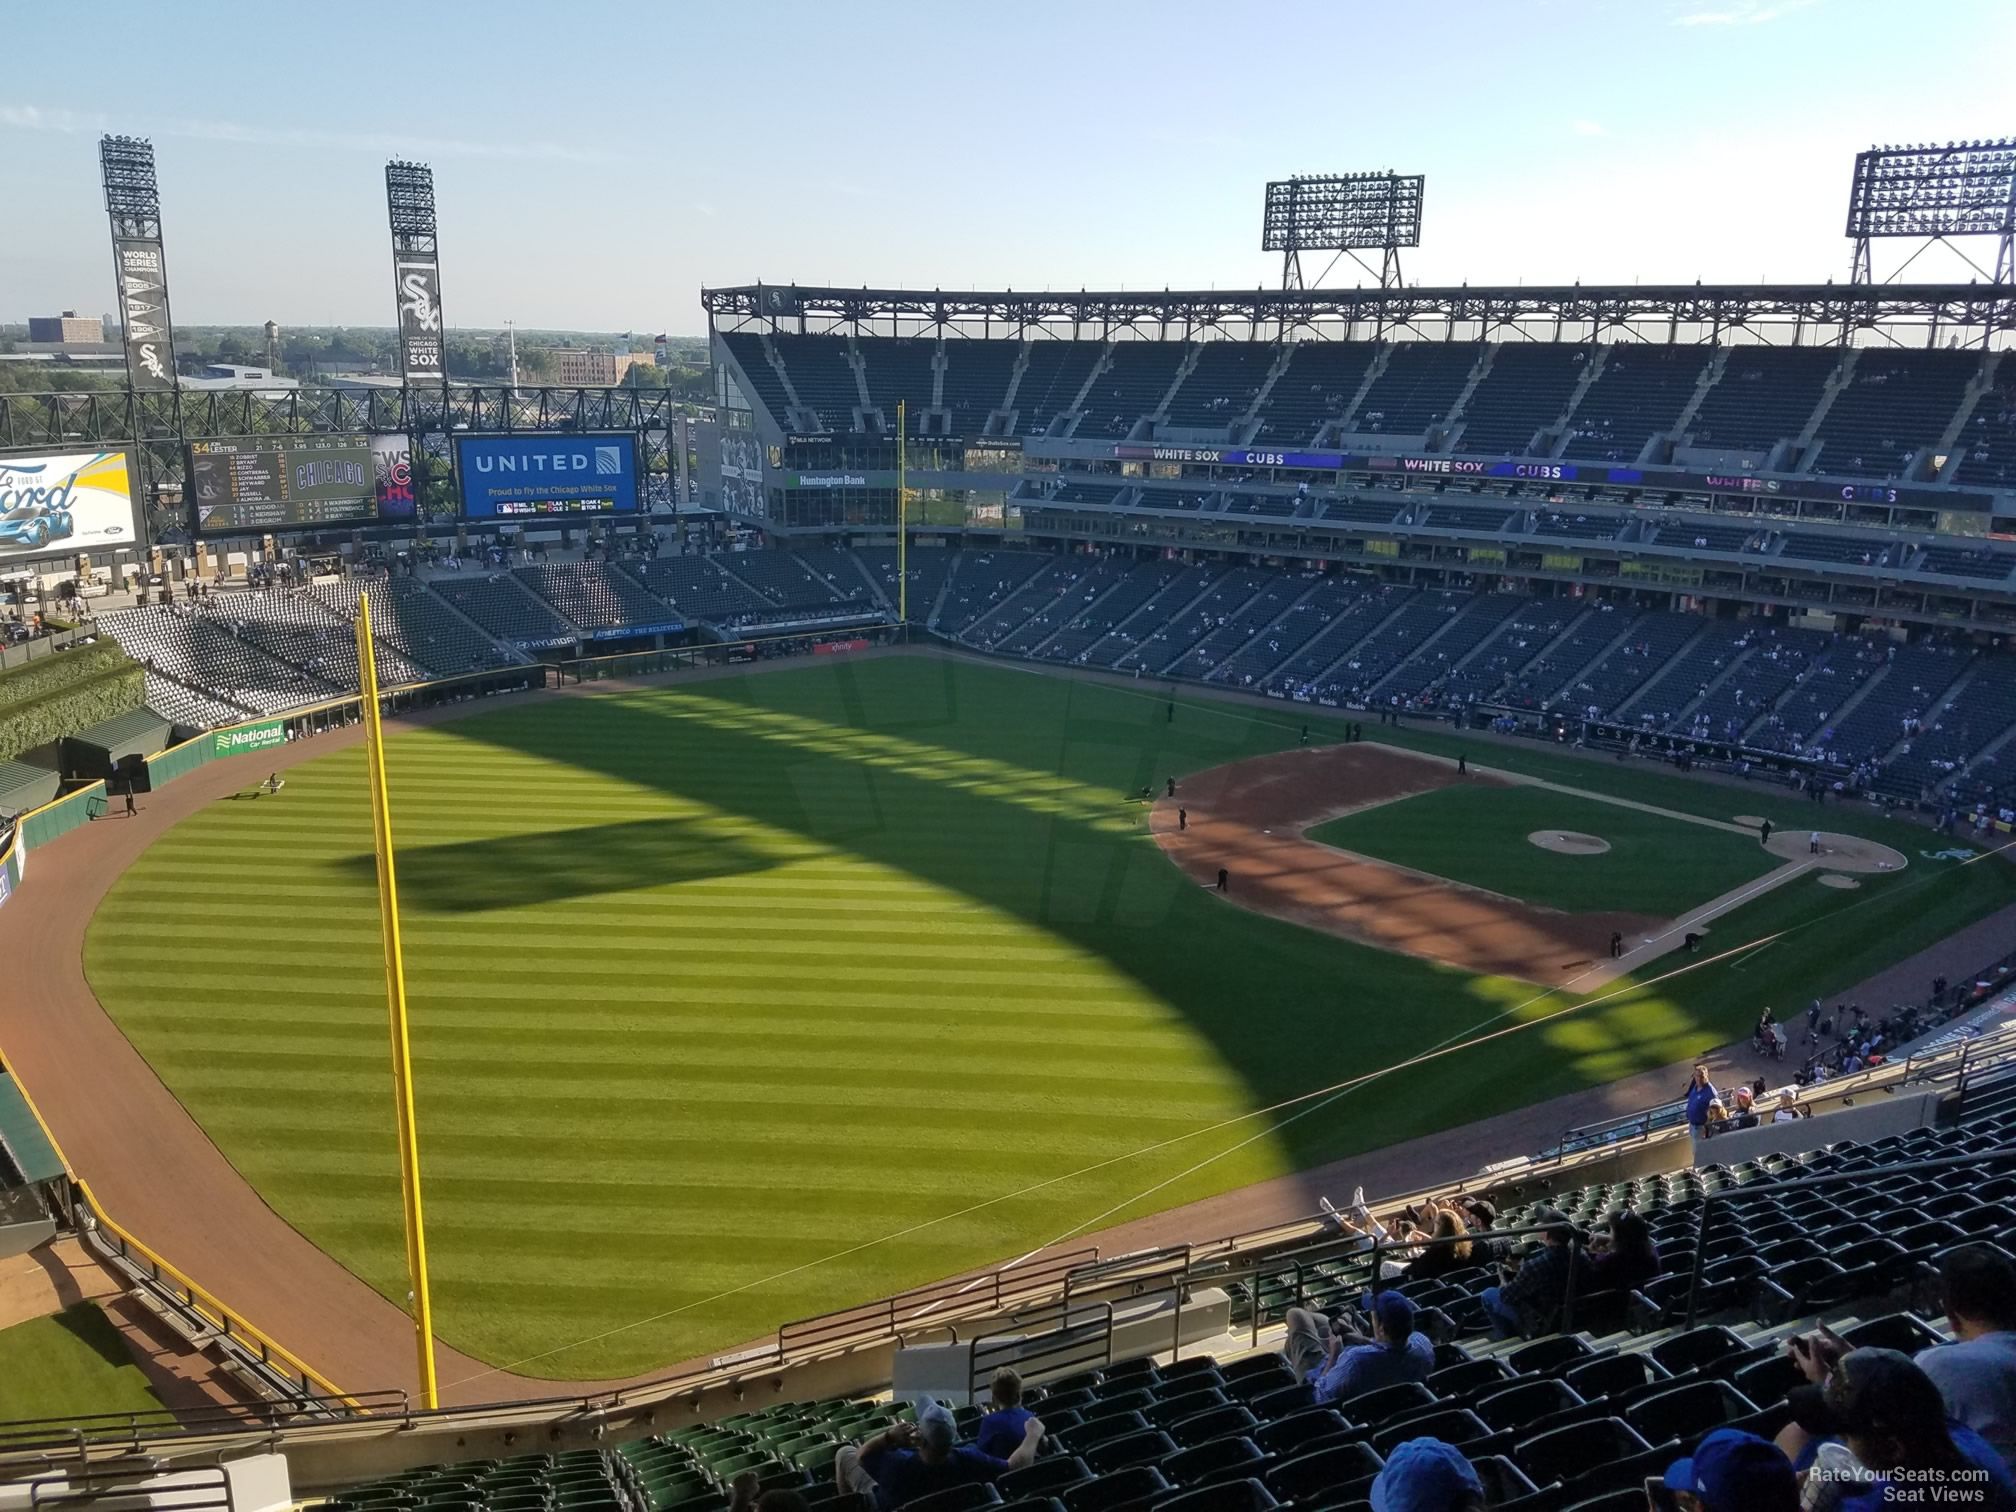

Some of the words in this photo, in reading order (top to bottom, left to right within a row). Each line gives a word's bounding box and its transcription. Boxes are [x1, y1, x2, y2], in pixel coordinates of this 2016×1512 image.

[123, 251, 156, 259] WORLD
[124, 259, 158, 267] SERIES
[410, 354, 439, 365] SOX
[192, 442, 209, 454] 34
[1153, 449, 1192, 460] WHITE
[1195, 451, 1219, 461] SOX
[1246, 453, 1284, 464] CUBS
[475, 454, 588, 472] UNITED
[1404, 459, 1450, 472] WHITE
[1455, 462, 1484, 472] SOX
[296, 460, 364, 489] CHICAGO
[1516, 465, 1561, 478] CUBS
[18, 477, 33, 485] FORD
[800, 476, 843, 487] Huntington
[844, 475, 865, 485] Bank
[488, 488, 512, 496] Proud
[524, 487, 535, 496] fly
[550, 486, 579, 495] Chicago
[595, 628, 631, 638] ATHLETICO
[648, 624, 682, 632] RELIEVERS
[531, 636, 577, 648] HYUNDAI
[832, 642, 852, 652] xfinity
[262, 737, 280, 745] Rental
